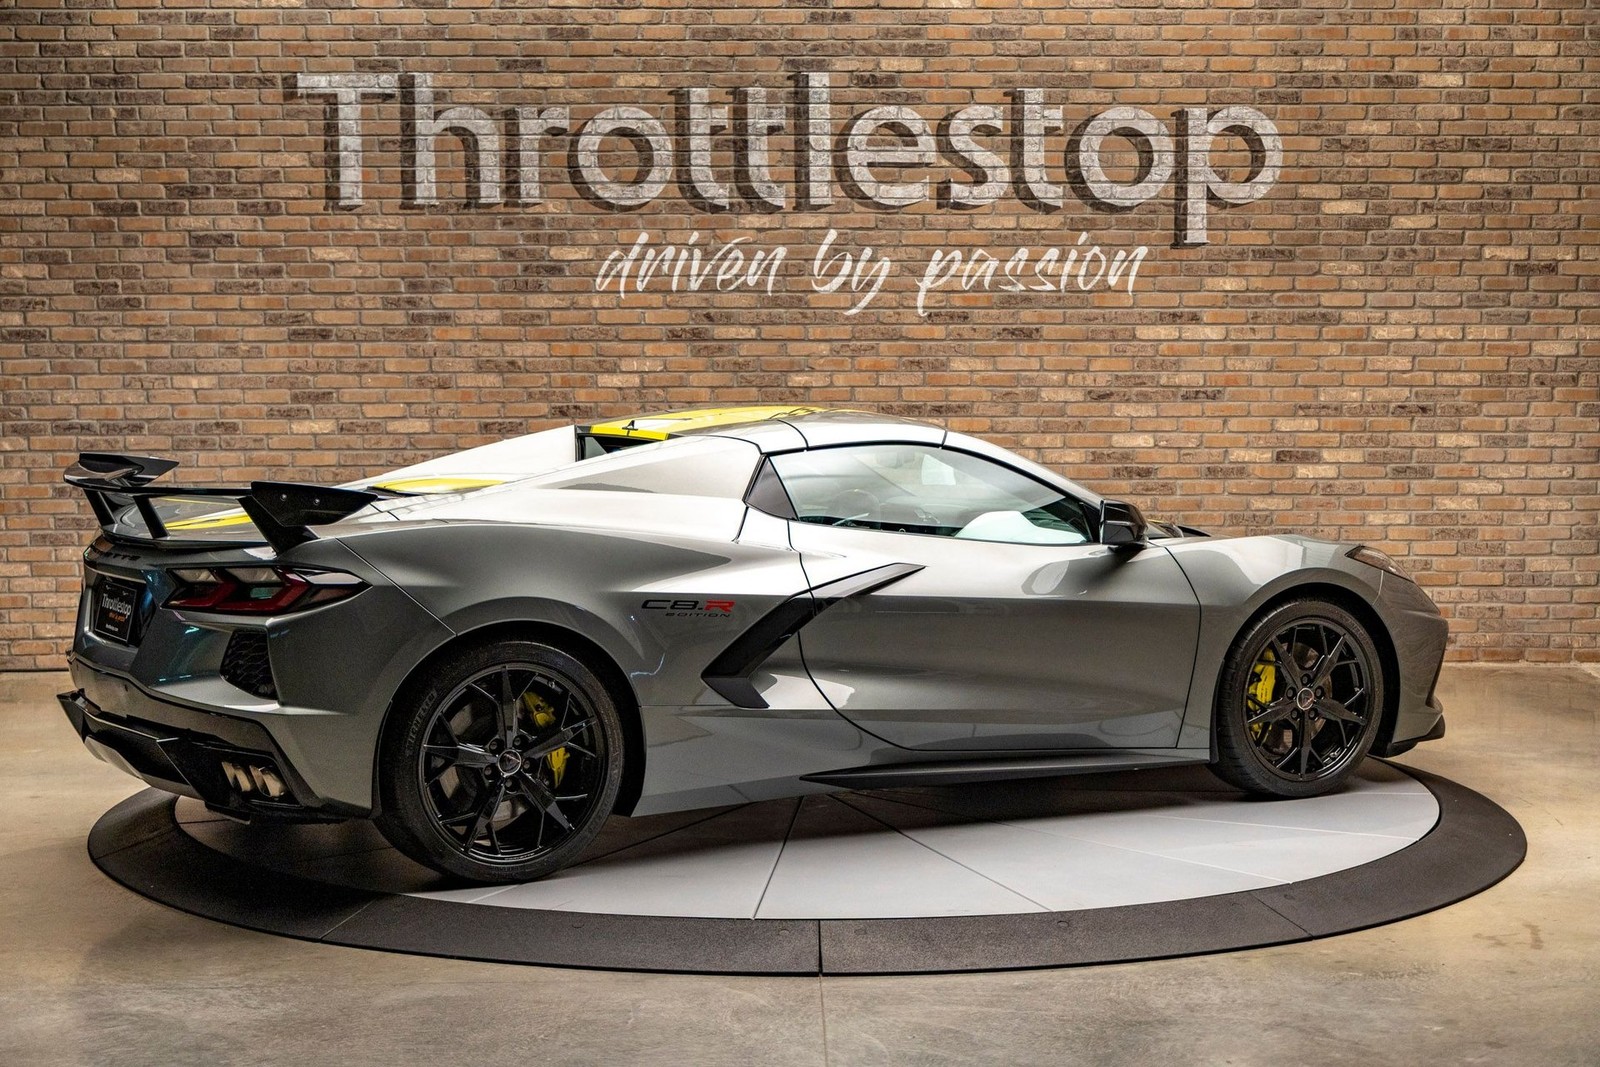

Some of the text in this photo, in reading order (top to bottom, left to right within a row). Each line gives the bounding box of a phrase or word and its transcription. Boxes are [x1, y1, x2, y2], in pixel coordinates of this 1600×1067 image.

[291, 71, 1284, 248] Throttlestop
[595, 228, 1149, 317] driven by passion
[641, 599, 736, 613] C8.R
